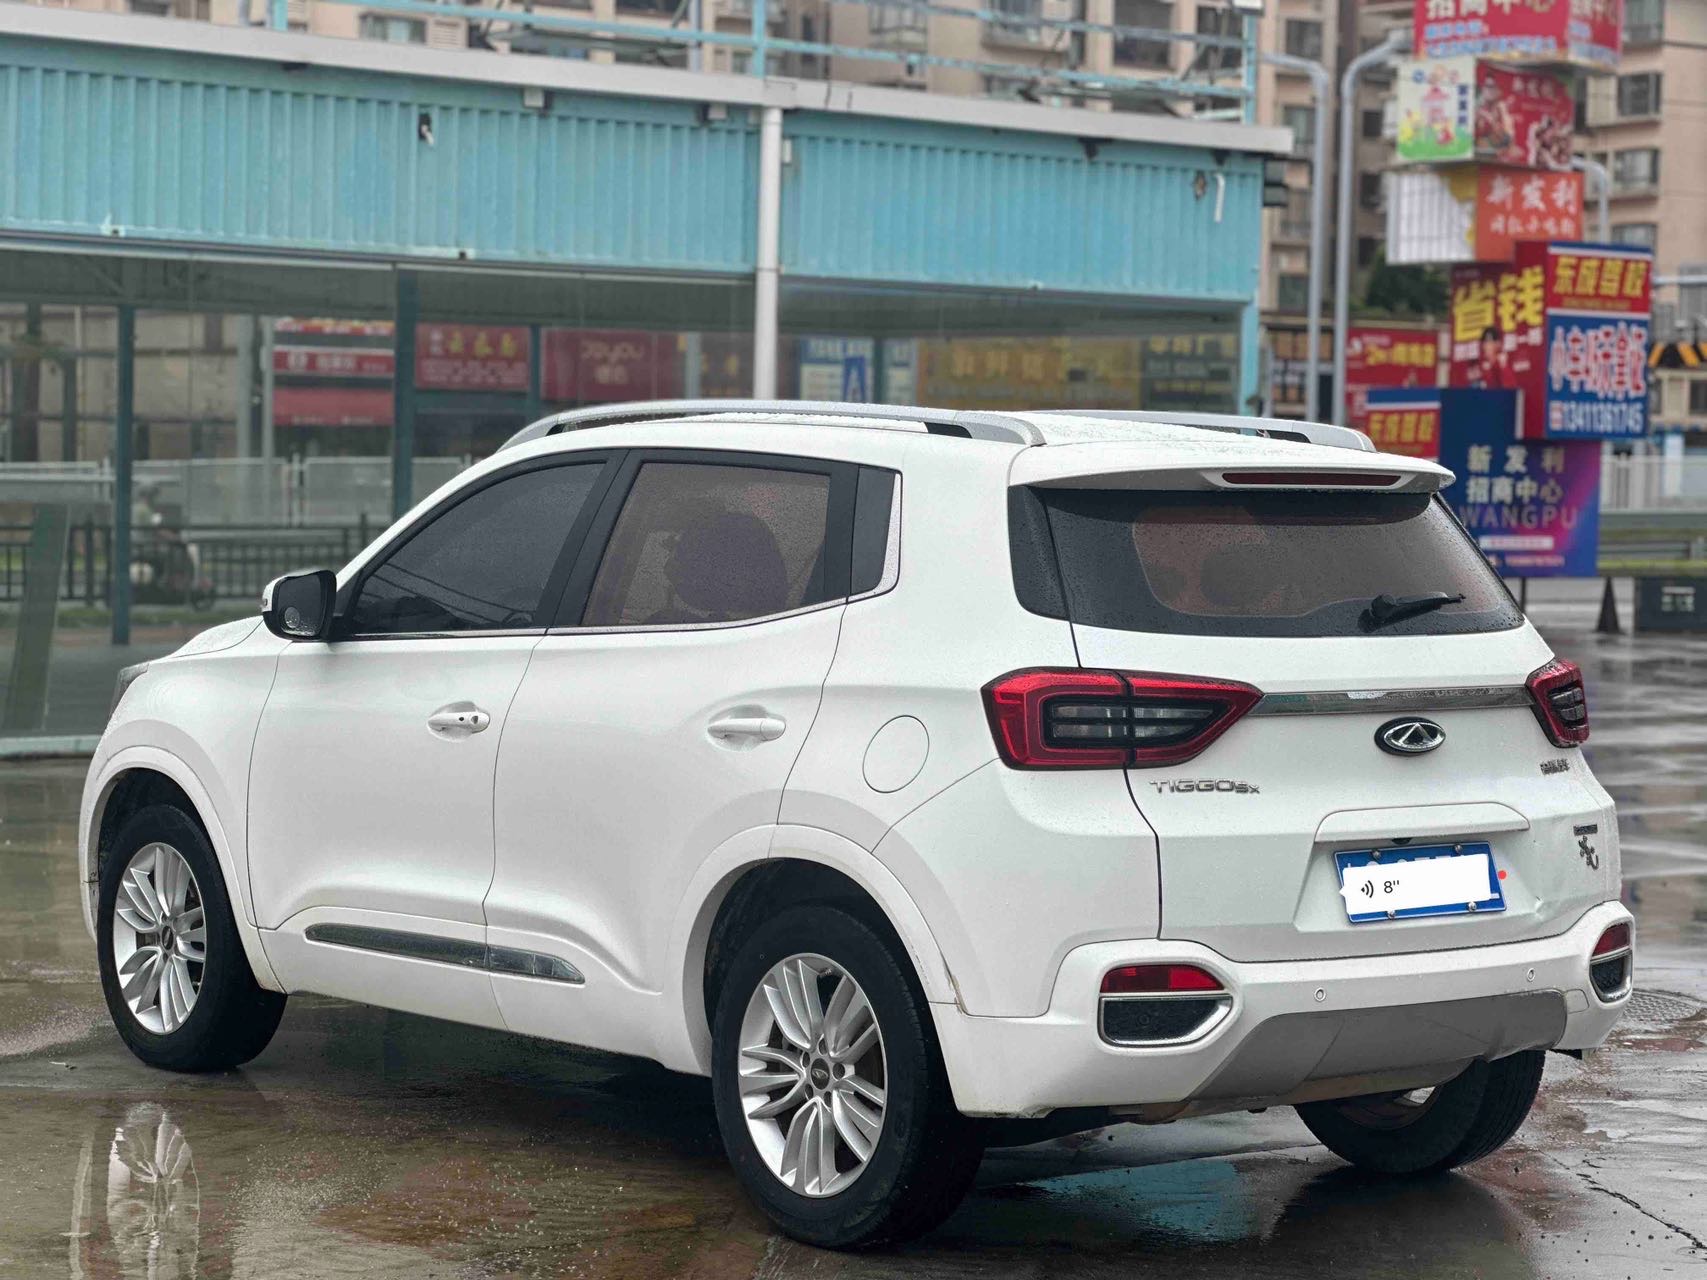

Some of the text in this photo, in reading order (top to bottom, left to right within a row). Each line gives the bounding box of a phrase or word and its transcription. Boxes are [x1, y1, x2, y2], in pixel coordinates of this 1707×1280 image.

[1468, 444, 1565, 473] 新发利
[1466, 475, 1564, 504] 招商中心
[1459, 504, 1578, 530] WANGPU
